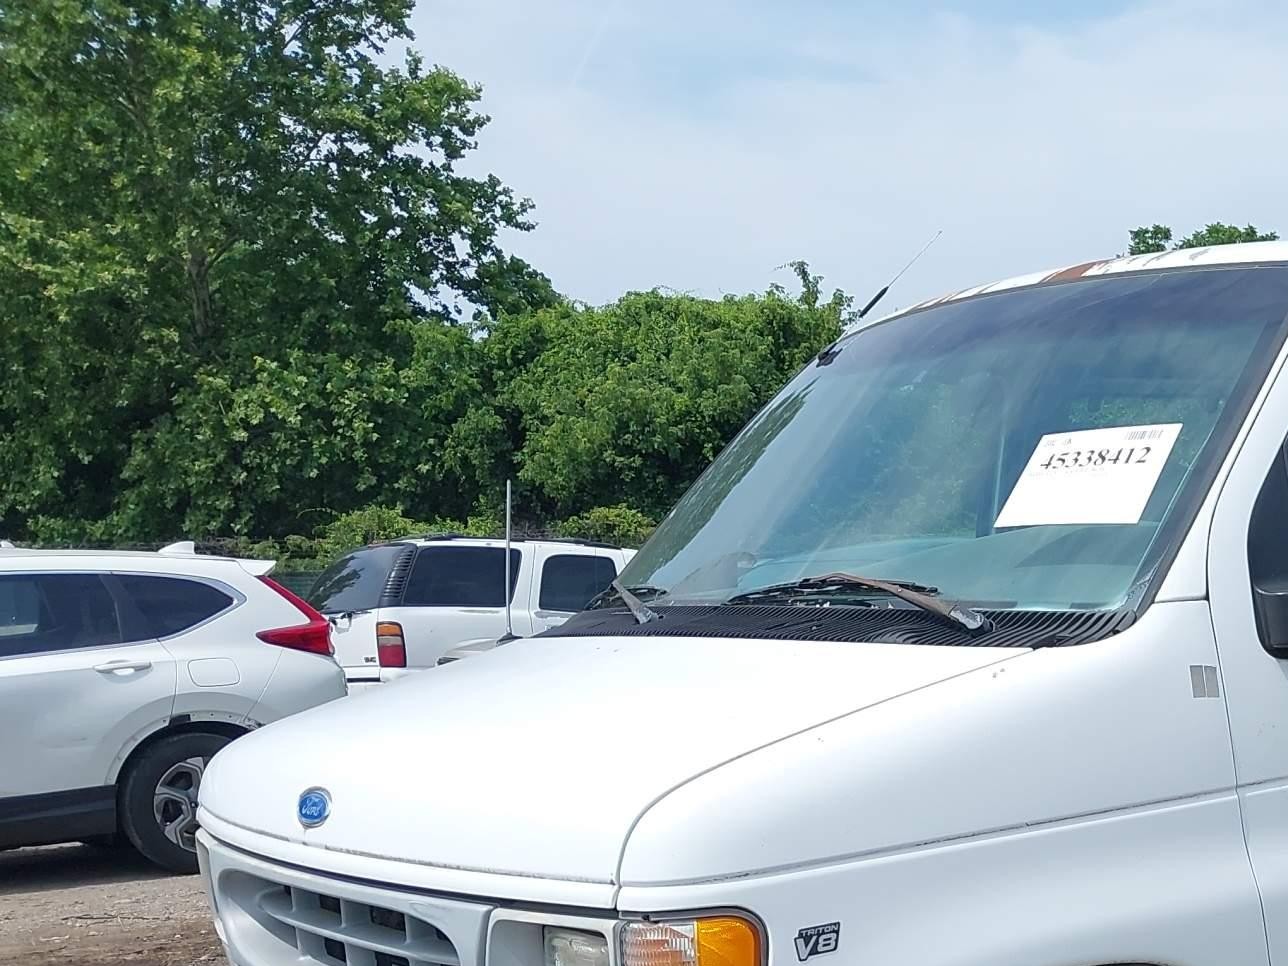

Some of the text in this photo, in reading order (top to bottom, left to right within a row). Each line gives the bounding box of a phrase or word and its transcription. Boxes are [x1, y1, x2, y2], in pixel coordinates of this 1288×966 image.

[1040, 446, 1152, 470] 45338412
[301, 796, 324, 817] Ford
[800, 923, 839, 937] TRITON
[795, 932, 838, 960] V8
